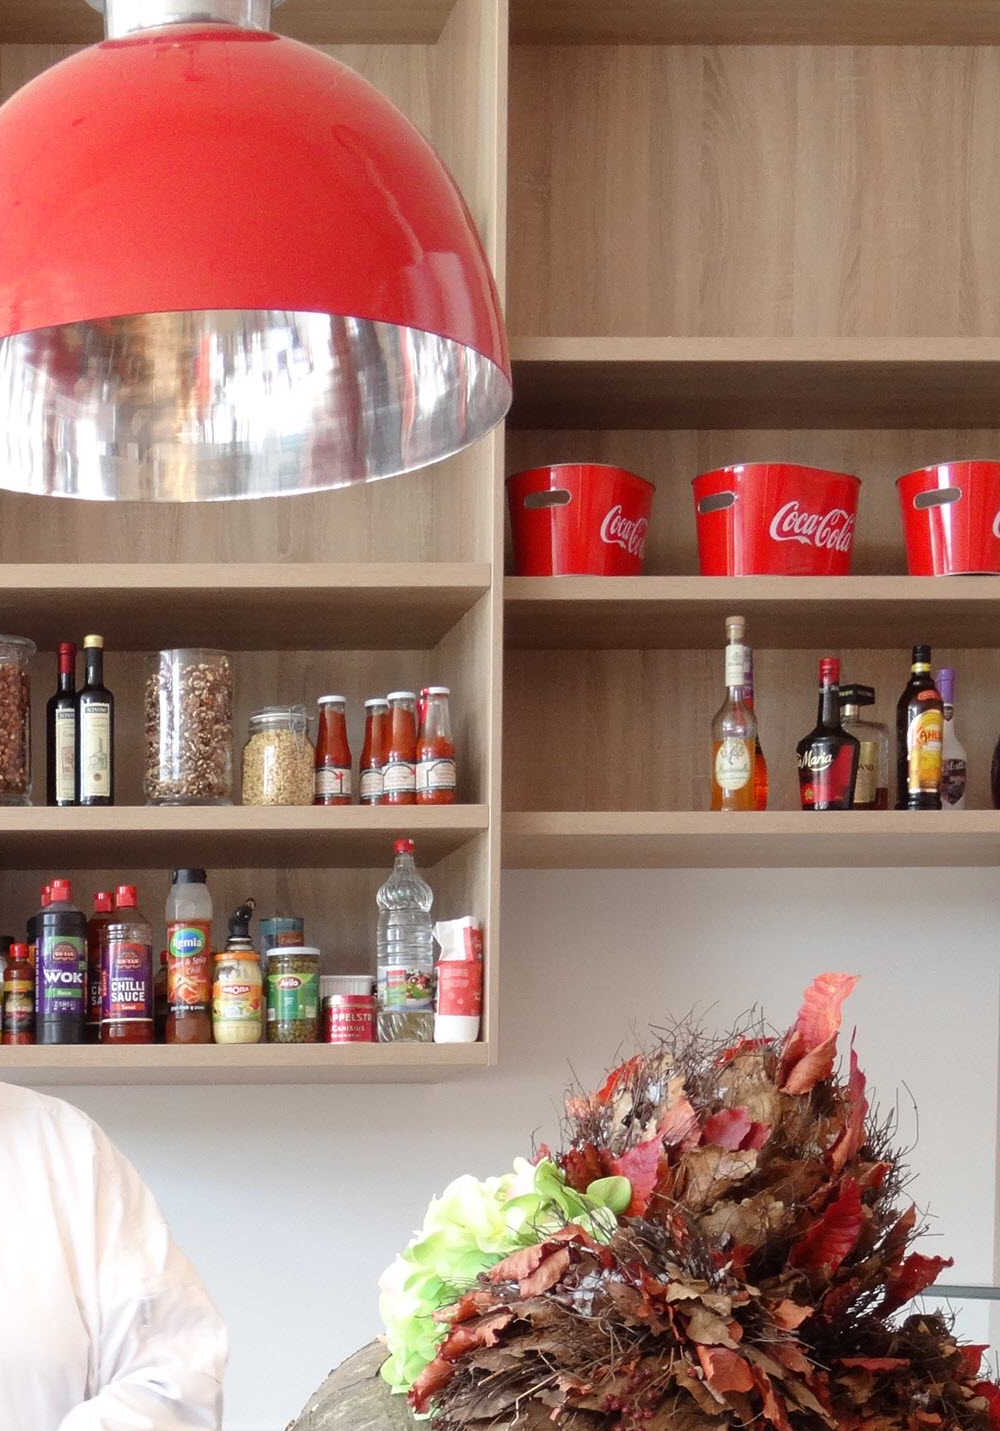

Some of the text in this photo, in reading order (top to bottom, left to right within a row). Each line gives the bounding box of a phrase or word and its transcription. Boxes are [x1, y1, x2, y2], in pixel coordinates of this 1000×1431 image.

[769, 500, 855, 552] Coca-Cola
[801, 750, 832, 768] Maria
[173, 937, 202, 949] Remia
[44, 971, 83, 983] WOK
[111, 981, 145, 992] CHILLI
[222, 986, 249, 995] AMORA
[111, 992, 145, 1002] SAUCE
